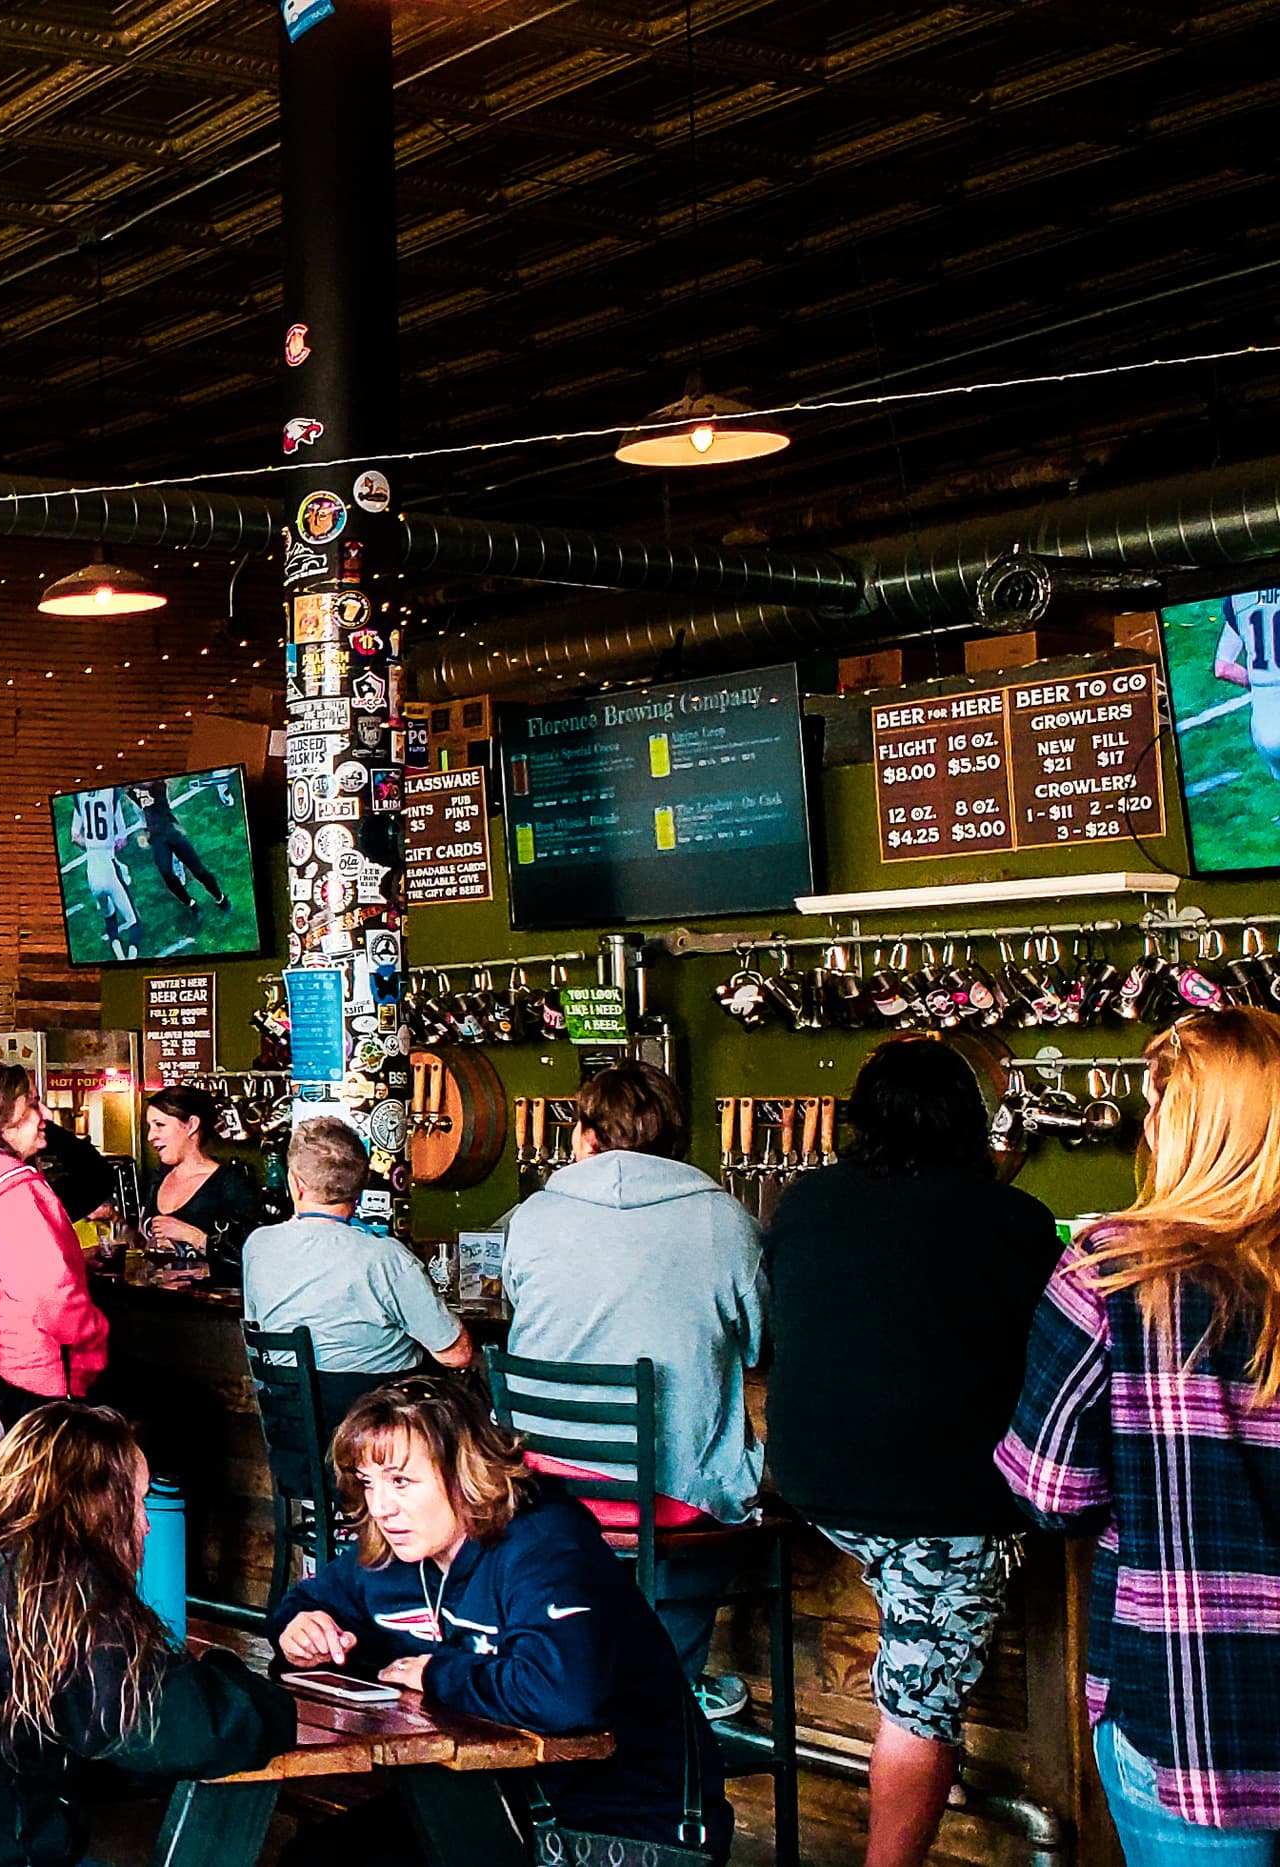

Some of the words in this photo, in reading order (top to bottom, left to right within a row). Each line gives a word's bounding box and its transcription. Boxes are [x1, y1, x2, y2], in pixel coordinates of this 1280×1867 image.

[1249, 611, 1280, 668] 1
[1016, 685, 1070, 708] BEER
[1075, 679, 1107, 700] TO
[1112, 672, 1147, 694] GO
[527, 713, 597, 738] Florence
[604, 699, 674, 727] Brewing
[679, 686, 763, 714] Company
[876, 708, 925, 730] BEER
[927, 708, 948, 720] FOR
[951, 696, 1003, 718] HERE
[1030, 703, 1133, 731] GROWLERS
[878, 737, 937, 761] FLIGHT
[947, 734, 968, 752] 16
[970, 731, 999, 749] OZ.
[1037, 738, 1076, 756] NEW
[1091, 732, 1130, 750] FILL
[883, 763, 936, 785] $8.00
[947, 753, 1001, 777] $5.50
[1043, 756, 1072, 774] $21
[1096, 750, 1126, 768] $17
[1034, 774, 1137, 799] CROWLERS
[451, 795, 471, 806] PUB
[1118, 796, 1153, 814] $20
[408, 804, 434, 818] INTS
[445, 805, 479, 819] PINTS
[888, 807, 908, 824] 12
[910, 805, 936, 822] OZ.
[955, 800, 967, 816] 8
[972, 798, 1000, 816] OZ.
[1049, 804, 1073, 821] $11
[84, 800, 108, 840] 16
[410, 820, 426, 832] $5
[454, 820, 471, 833] $8
[887, 826, 940, 848] $4.25
[952, 820, 1006, 843] $3.00
[1085, 820, 1120, 838] $28
[436, 842, 483, 858] CARDS
[406, 865, 456, 878] ELOADABLE
[456, 862, 486, 872] CARDS
[458, 874, 480, 884] GIVE
[406, 890, 423, 900] THE
[425, 888, 444, 898] GIFT
[445, 887, 458, 896] OF
[150, 978, 186, 990] WINTER'S
[188, 978, 208, 988] HERE
[150, 990, 178, 1004] BEER
[180, 989, 208, 1002] GEAR
[567, 988, 589, 1000] YOU
[590, 988, 622, 1002] LOOK
[566, 1004, 589, 1016] LIKE
[594, 1004, 622, 1015] NEED
[584, 1020, 592, 1030] A
[50, 1078, 73, 1087] HOT
[389, 1072, 408, 1084] BSG
